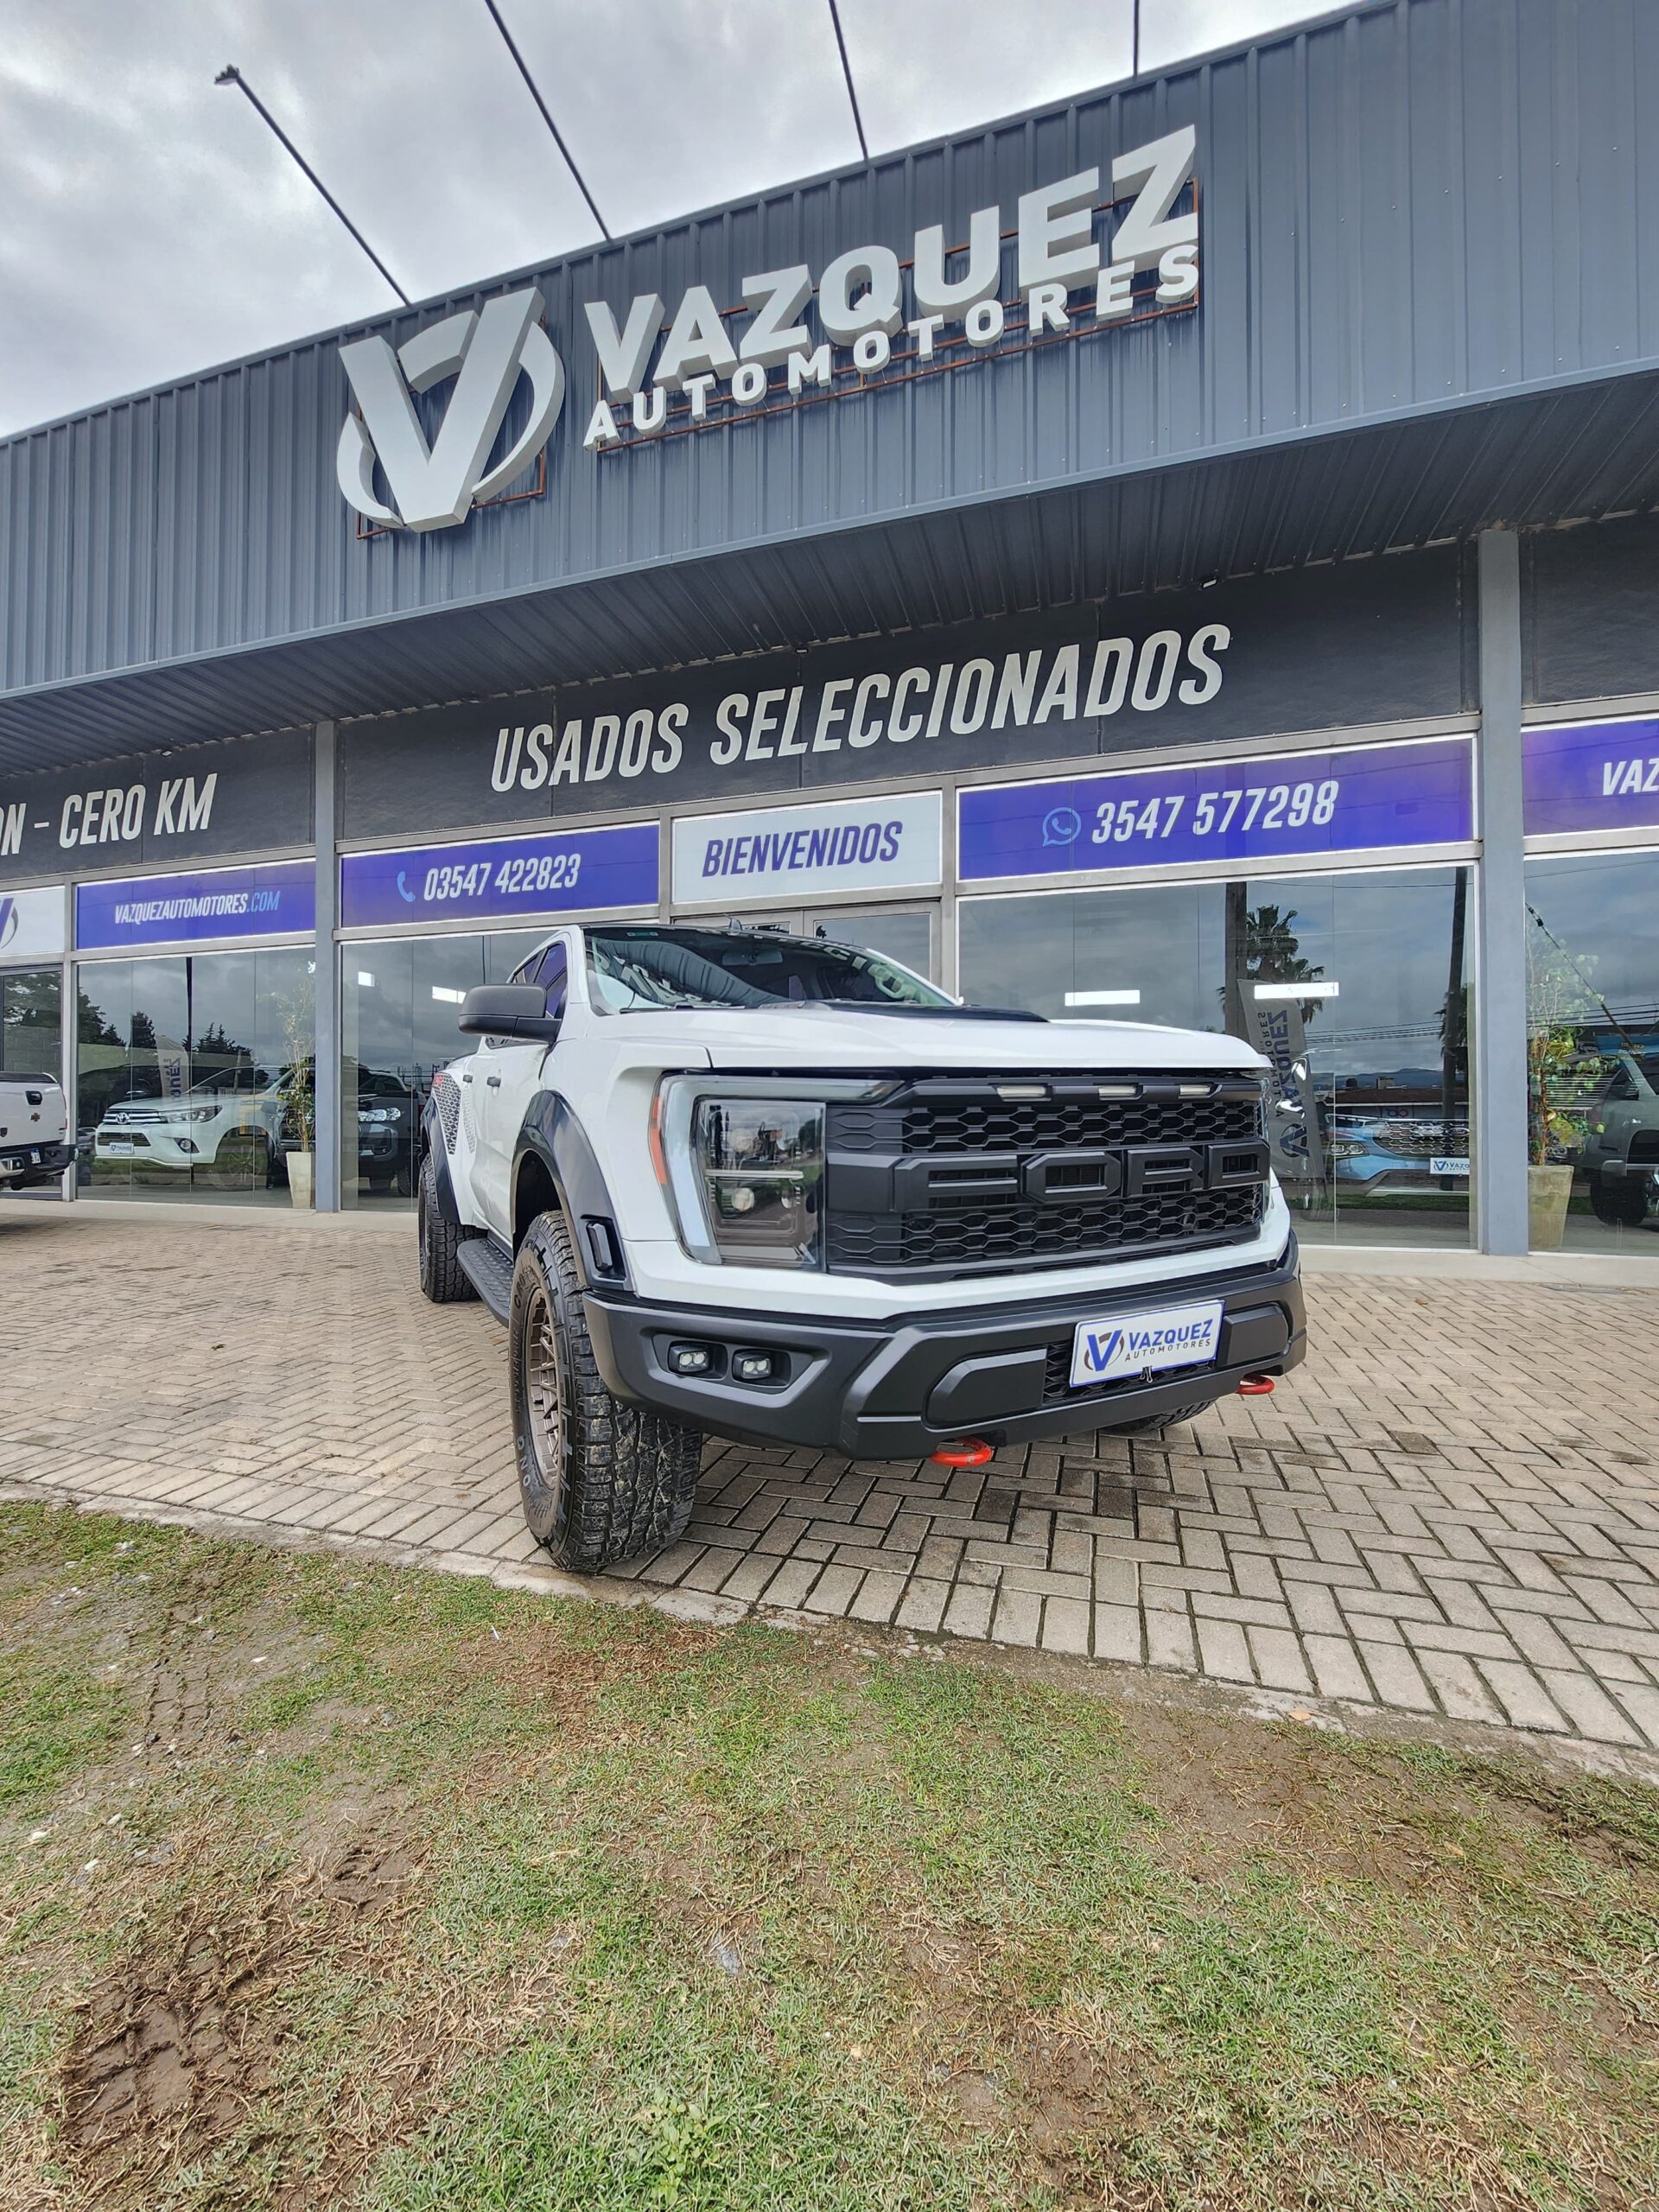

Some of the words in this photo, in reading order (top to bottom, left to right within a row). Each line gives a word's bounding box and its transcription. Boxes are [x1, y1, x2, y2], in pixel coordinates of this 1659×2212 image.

[584, 125, 1198, 403] VAZQUEZ
[583, 244, 1199, 450] AUTOMOTORES
[491, 703, 690, 792] USADOS
[709, 624, 1230, 765] SELECCIONADOS
[1603, 757, 1659, 796] VAZ
[59, 784, 147, 849] CERO
[154, 772, 218, 836] KM
[1092, 795, 1185, 844] 3547
[1192, 780, 1339, 836] 577298
[423, 862, 493, 901] 03547
[494, 853, 582, 893] 422823
[701, 821, 903, 878] BIENVENIDOS
[115, 890, 281, 925] VAZQUEZAUTOMOTORES.COM
[893, 1139, 1271, 1211] FORD
[1124, 1339, 1211, 1363] AUTOMOTORES
[1128, 1319, 1214, 1351] VAZQUEZ
